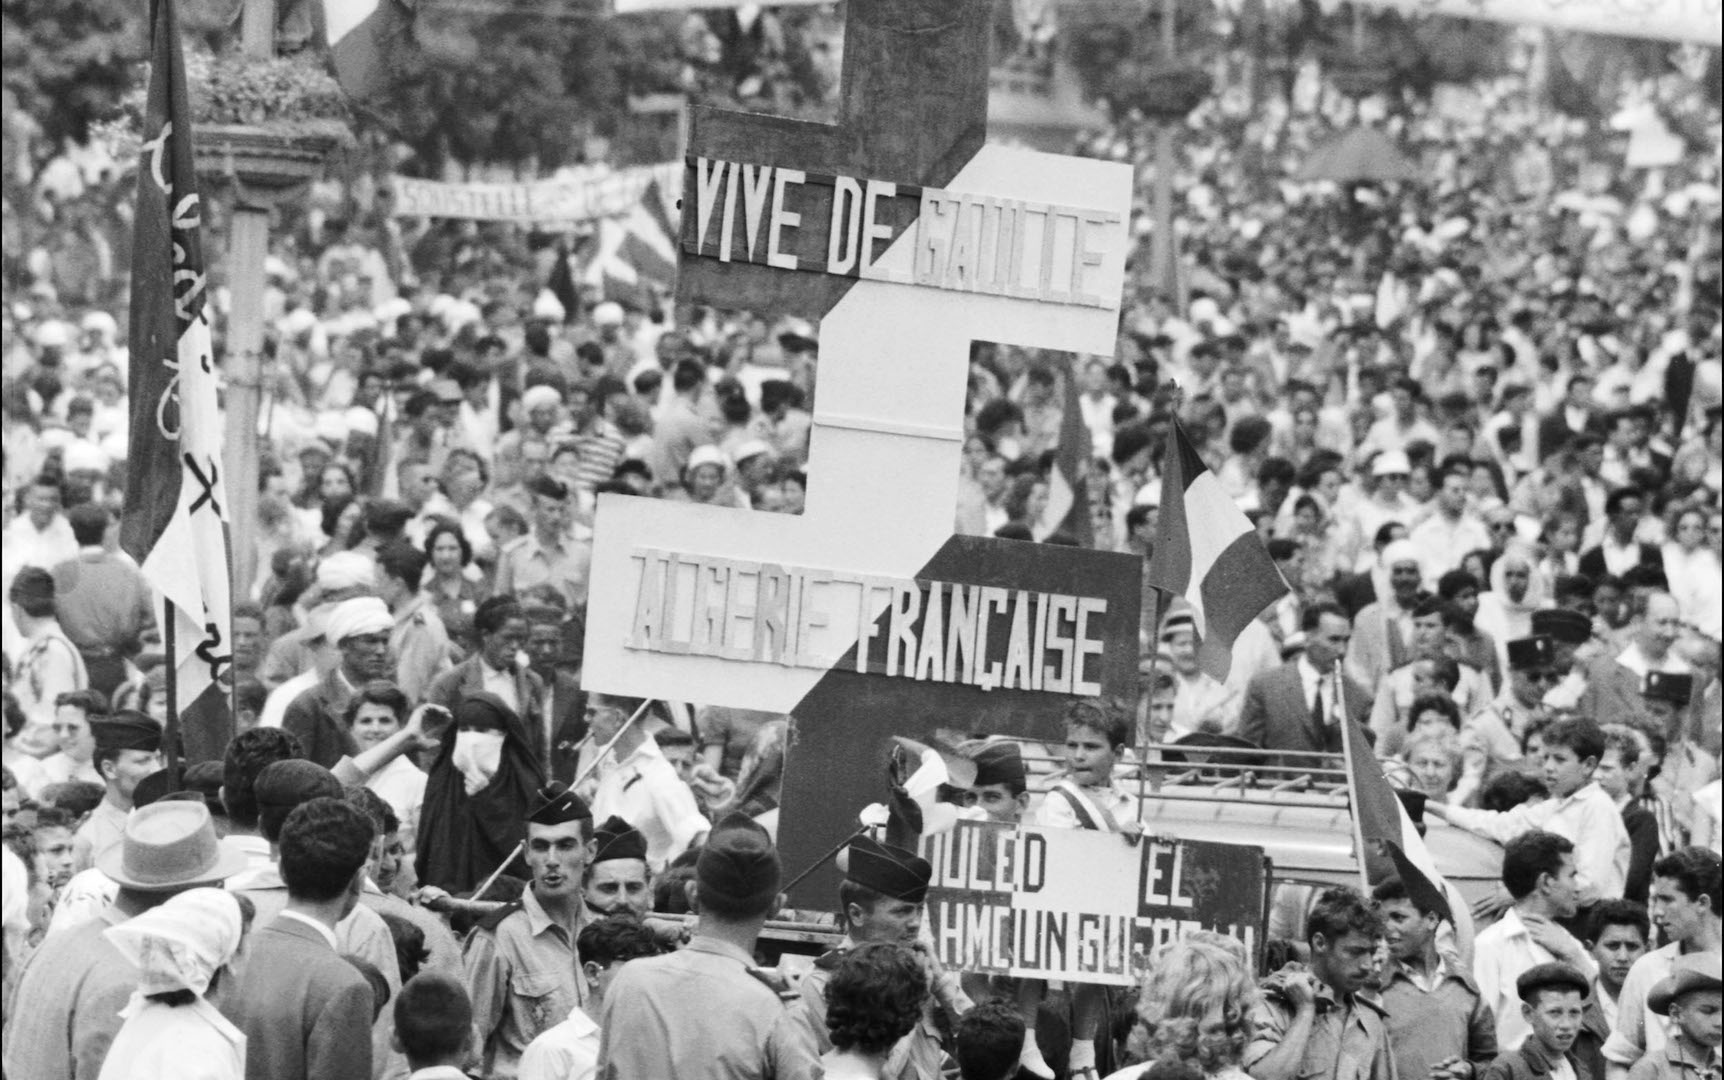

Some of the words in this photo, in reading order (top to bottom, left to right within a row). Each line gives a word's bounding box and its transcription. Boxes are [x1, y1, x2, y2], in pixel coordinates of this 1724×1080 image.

[698, 157, 806, 270] VIVE
[827, 175, 897, 282] DE
[914, 187, 1120, 311] GAULLE
[856, 577, 1108, 697] FRANÇAISE
[1145, 842, 1193, 908] EL
